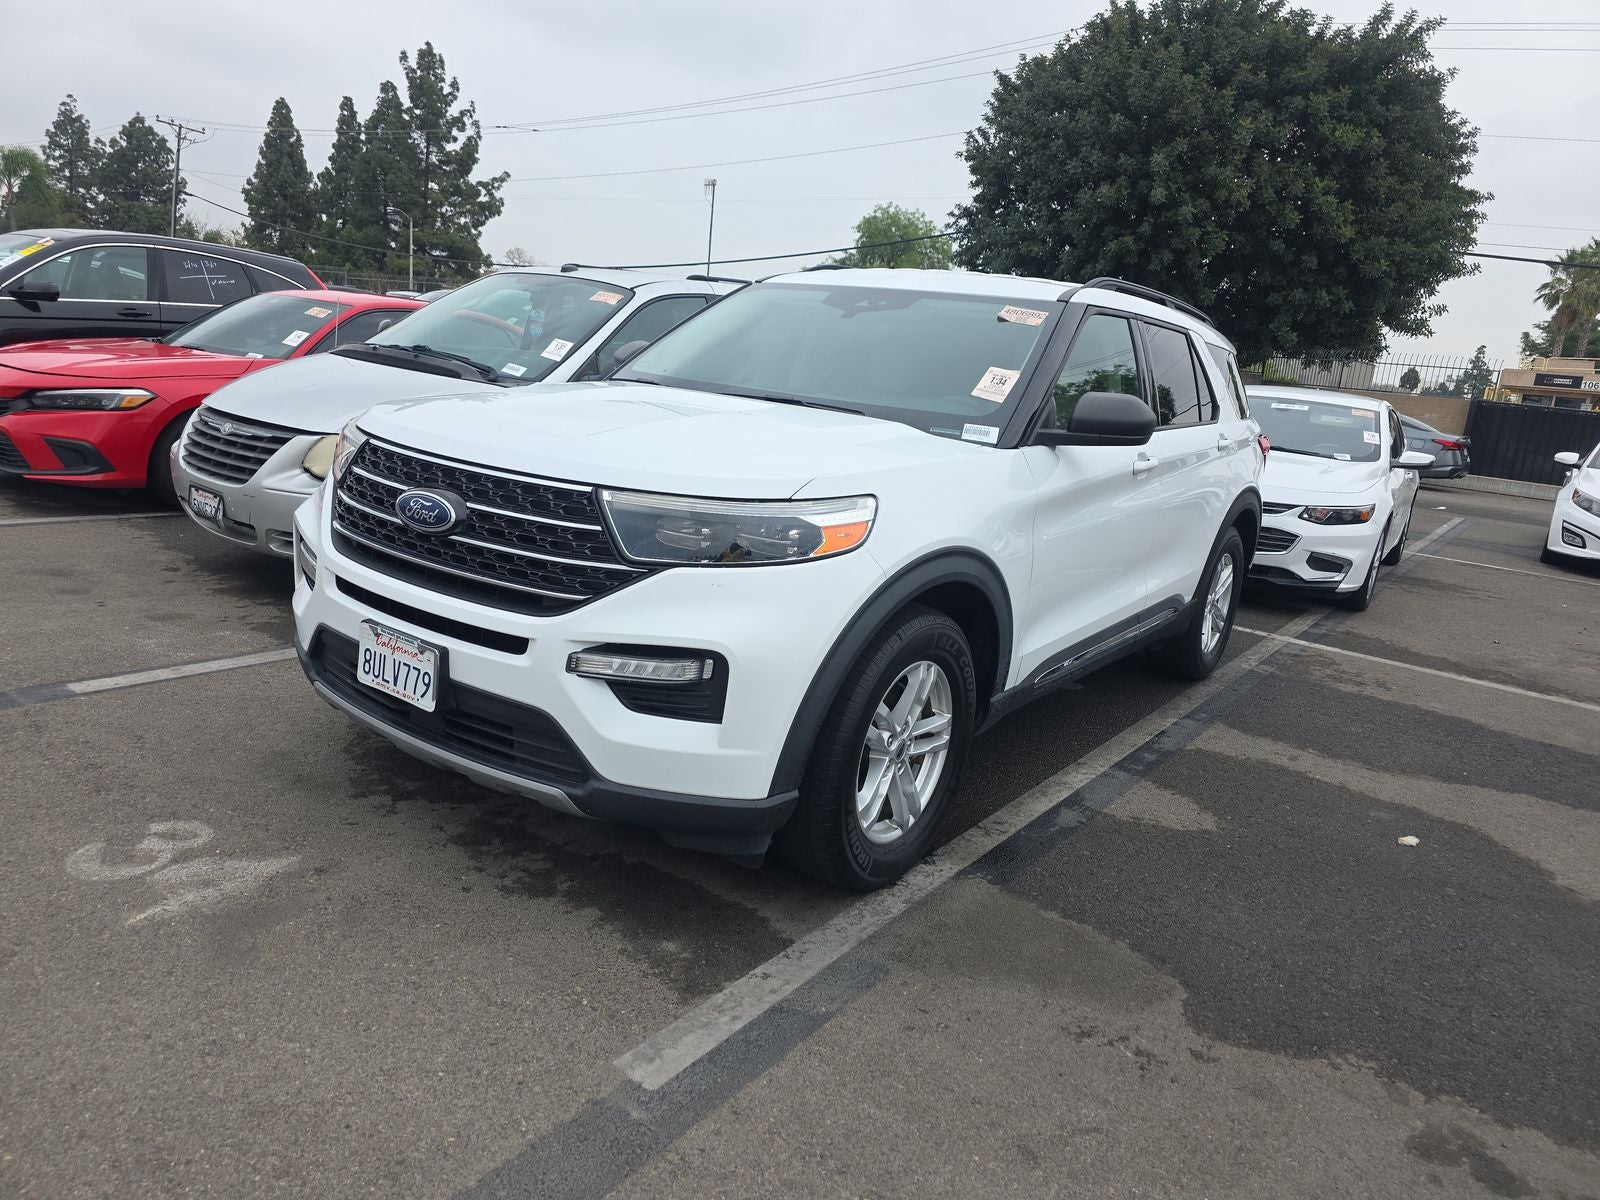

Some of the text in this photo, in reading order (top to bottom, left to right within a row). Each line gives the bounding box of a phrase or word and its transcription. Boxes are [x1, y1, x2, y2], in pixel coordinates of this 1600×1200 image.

[990, 376, 1008, 386] 1:34
[405, 497, 439, 523] Ford
[374, 633, 424, 662] California
[362, 647, 432, 699] 8ULV779
